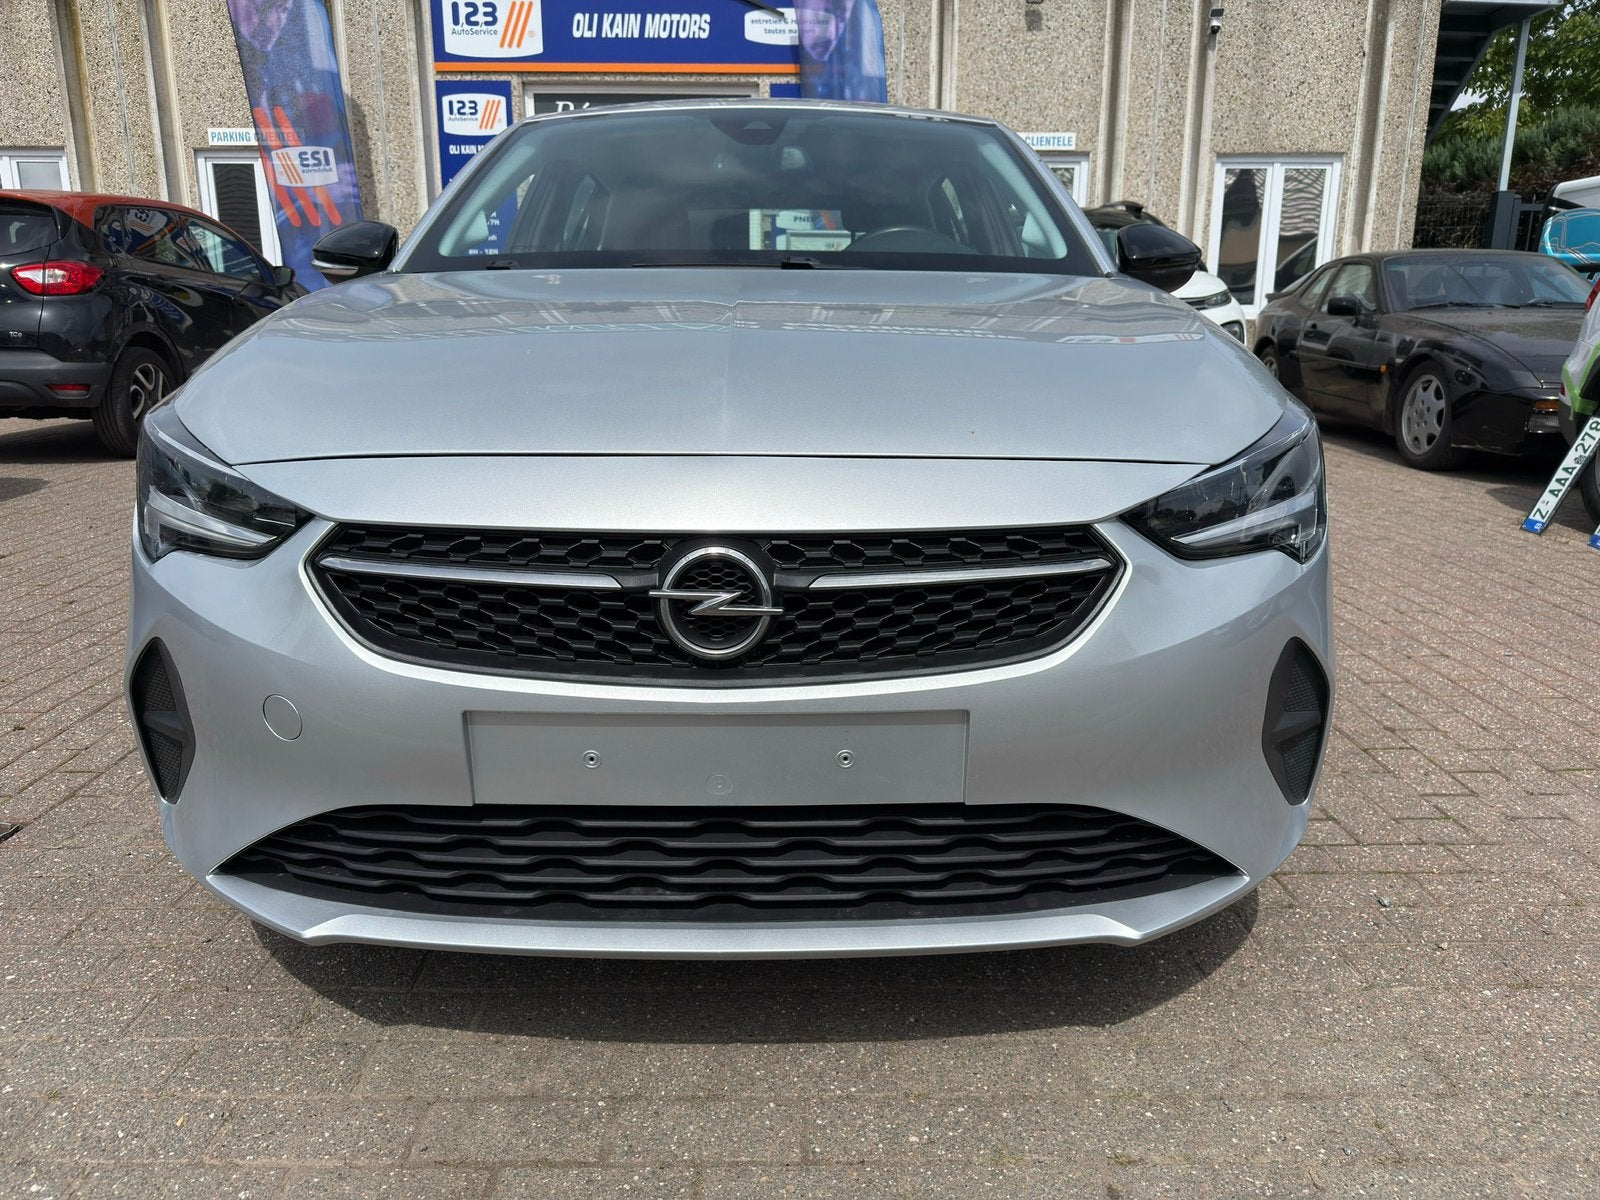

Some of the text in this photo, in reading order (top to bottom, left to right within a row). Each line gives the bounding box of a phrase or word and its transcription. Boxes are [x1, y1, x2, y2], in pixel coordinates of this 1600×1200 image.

[451, 27, 498, 36] AutoService
[572, 13, 711, 39] OLI KAIN MOTORS
[211, 131, 251, 143] PARKING
[449, 145, 460, 155] OLI
